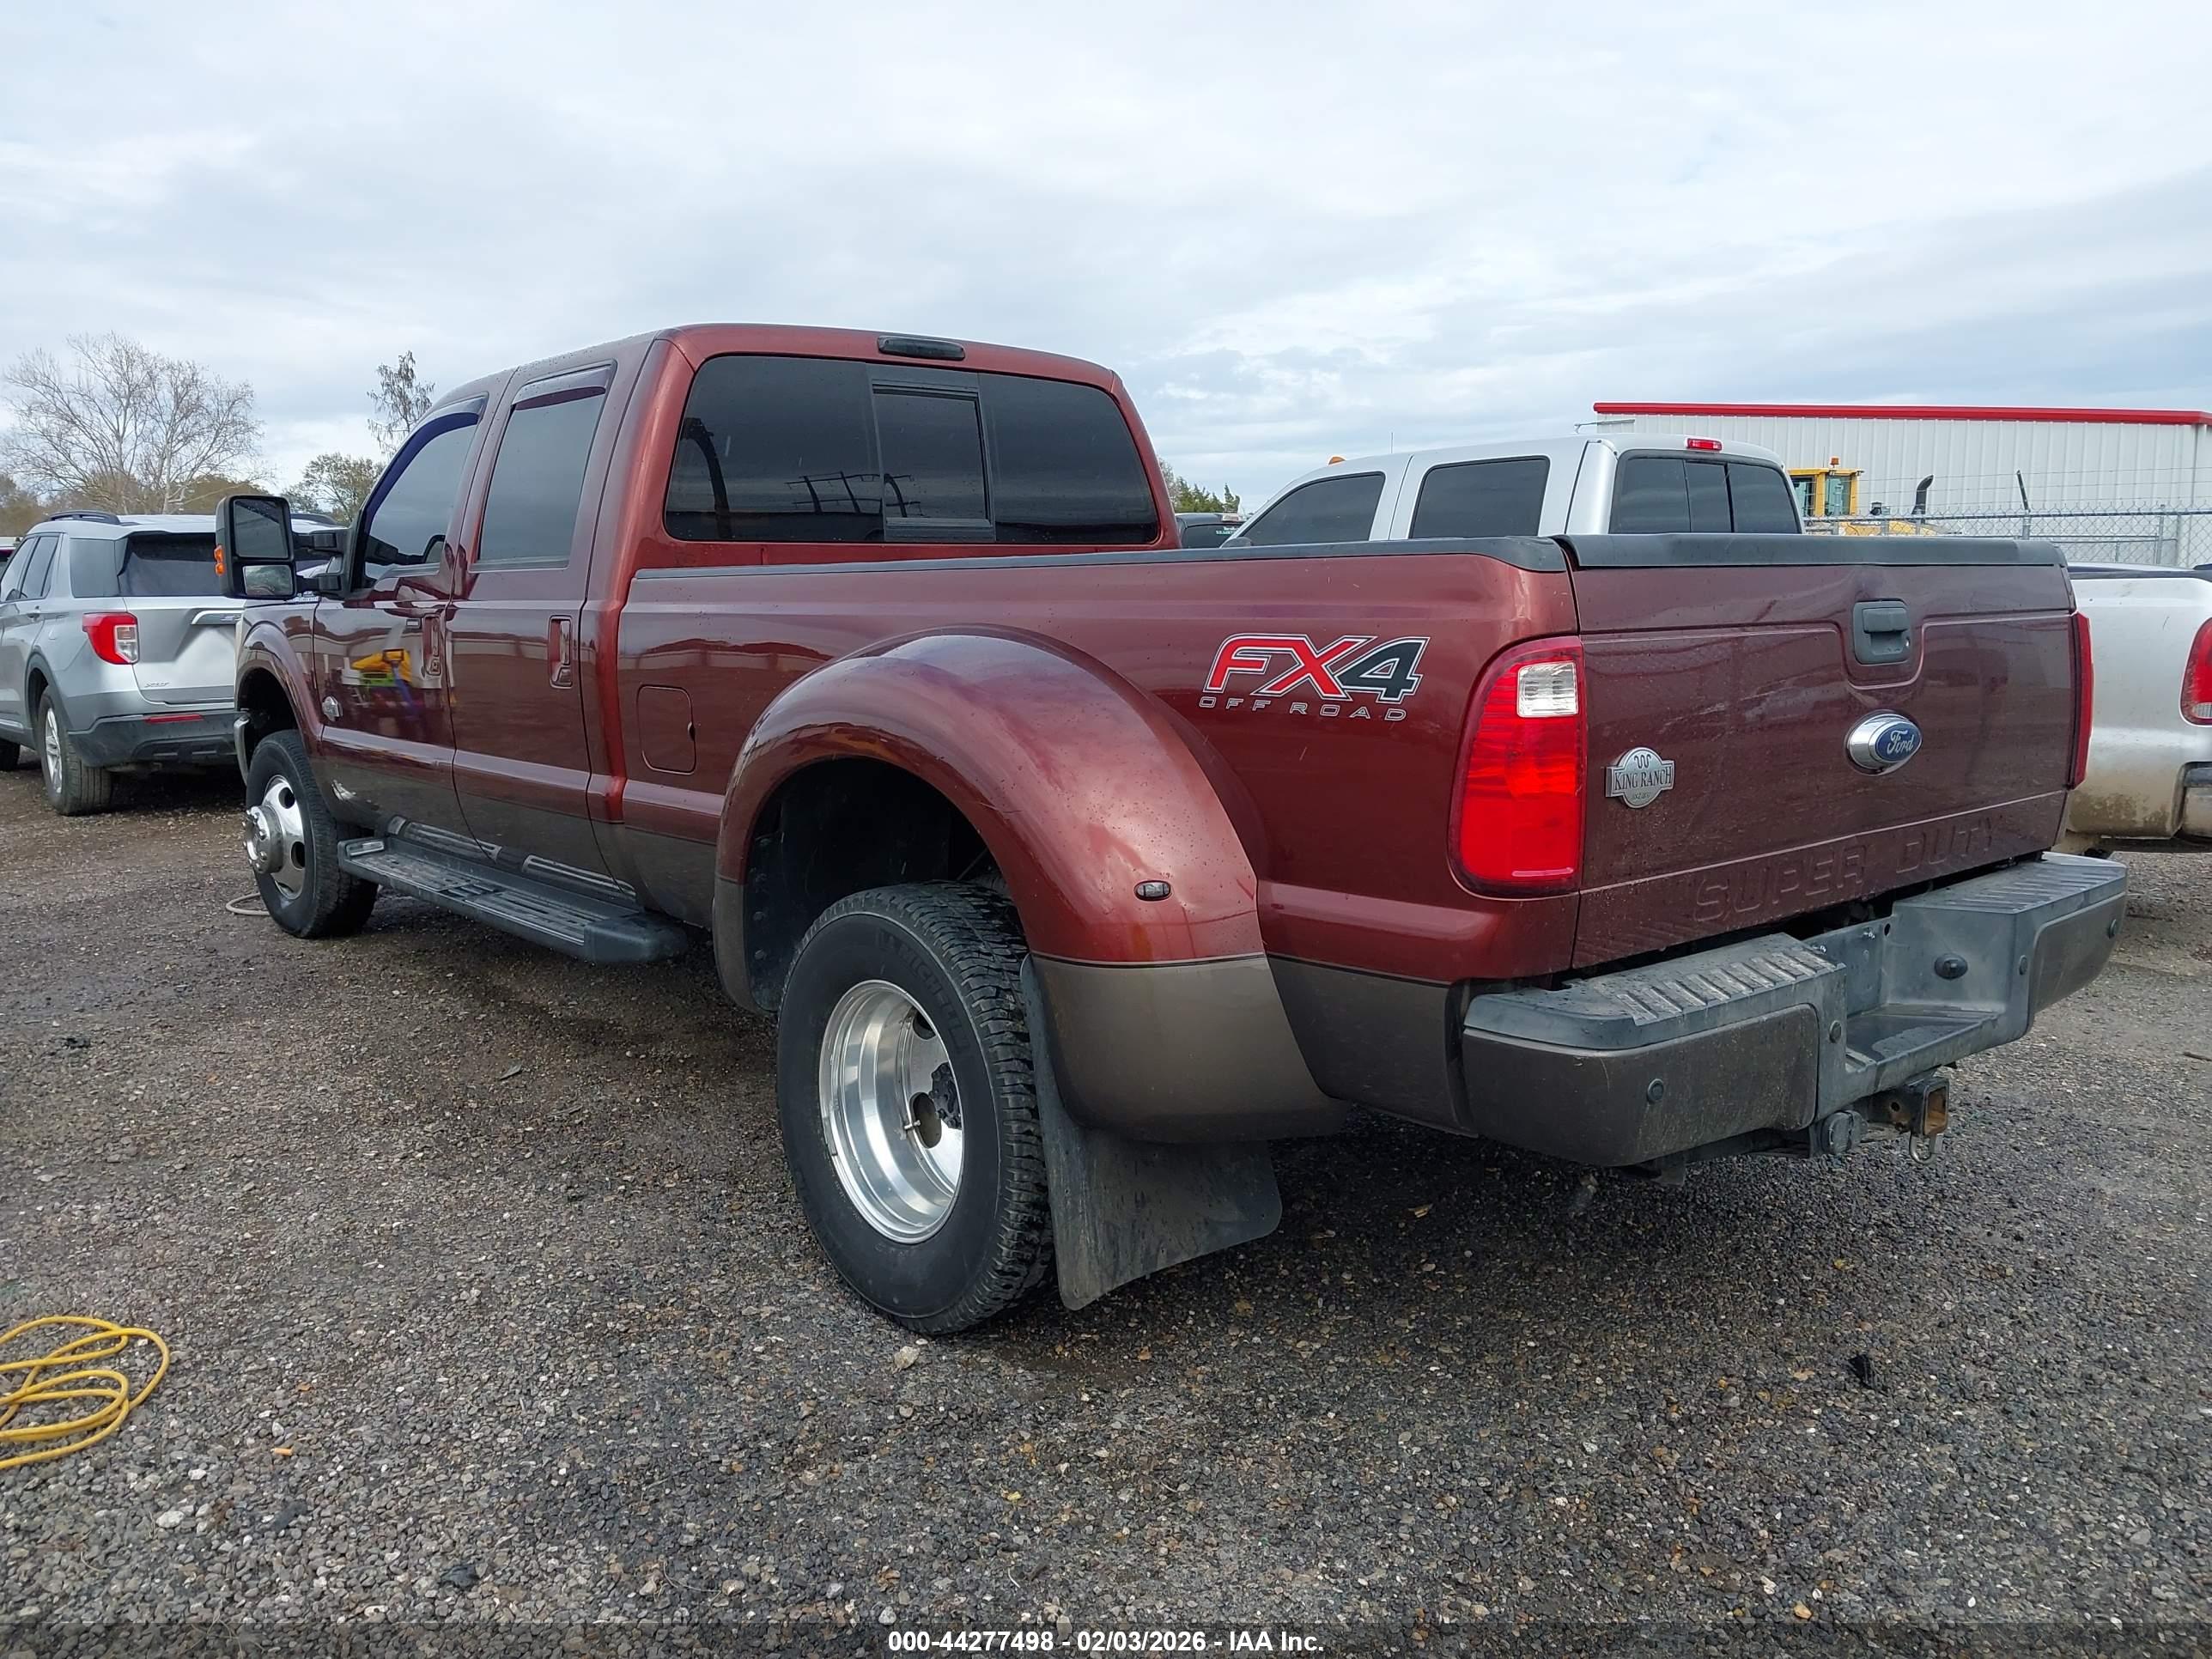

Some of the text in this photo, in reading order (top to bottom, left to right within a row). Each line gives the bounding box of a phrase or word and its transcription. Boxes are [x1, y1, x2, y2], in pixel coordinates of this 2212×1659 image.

[1202, 633, 1430, 704] FX4
[1199, 696, 1407, 721] OFF ROAD
[1887, 729, 1915, 755] Ford
[1614, 766, 1672, 790] KING RANCH
[1692, 816, 2002, 922] SUPER DUTY
